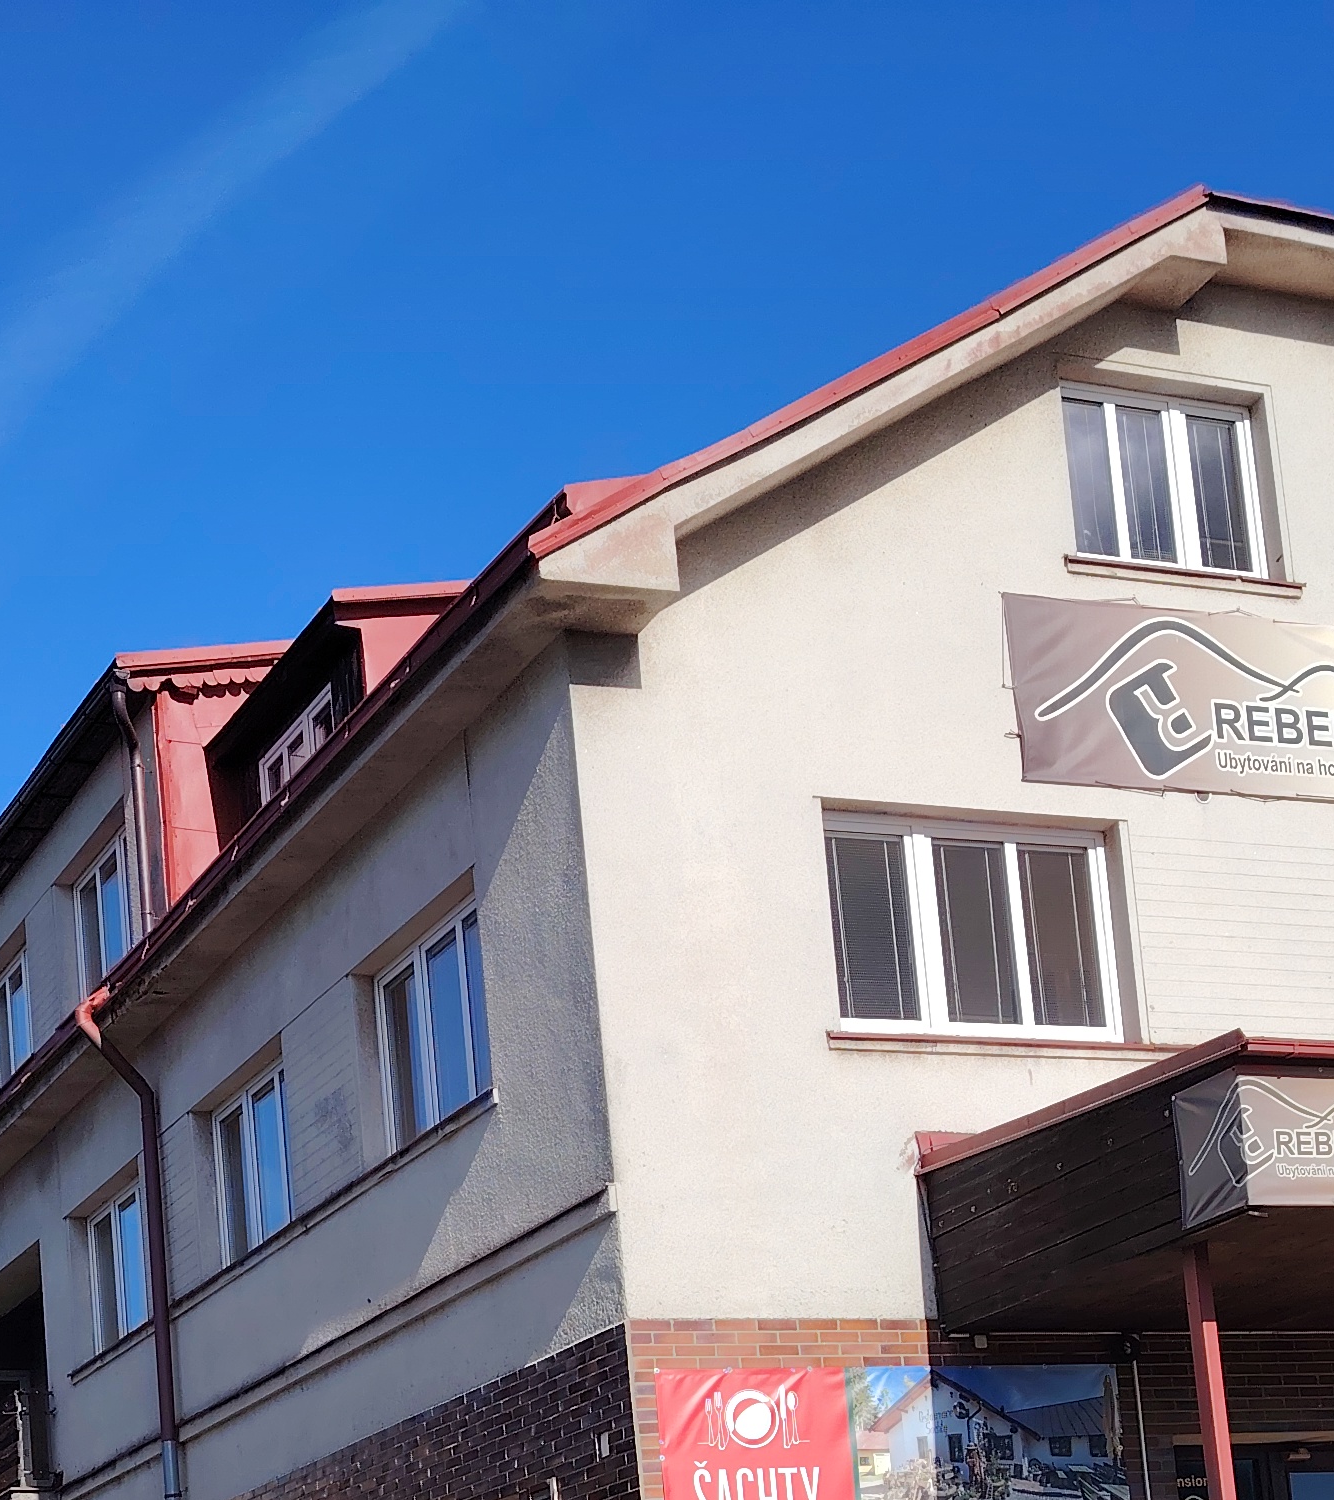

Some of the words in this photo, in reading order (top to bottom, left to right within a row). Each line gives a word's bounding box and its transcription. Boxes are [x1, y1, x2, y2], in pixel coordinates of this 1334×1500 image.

[1216, 751, 1293, 775] Ubytování
[1296, 761, 1315, 775] na
[1276, 1164, 1326, 1179] Ubytování
